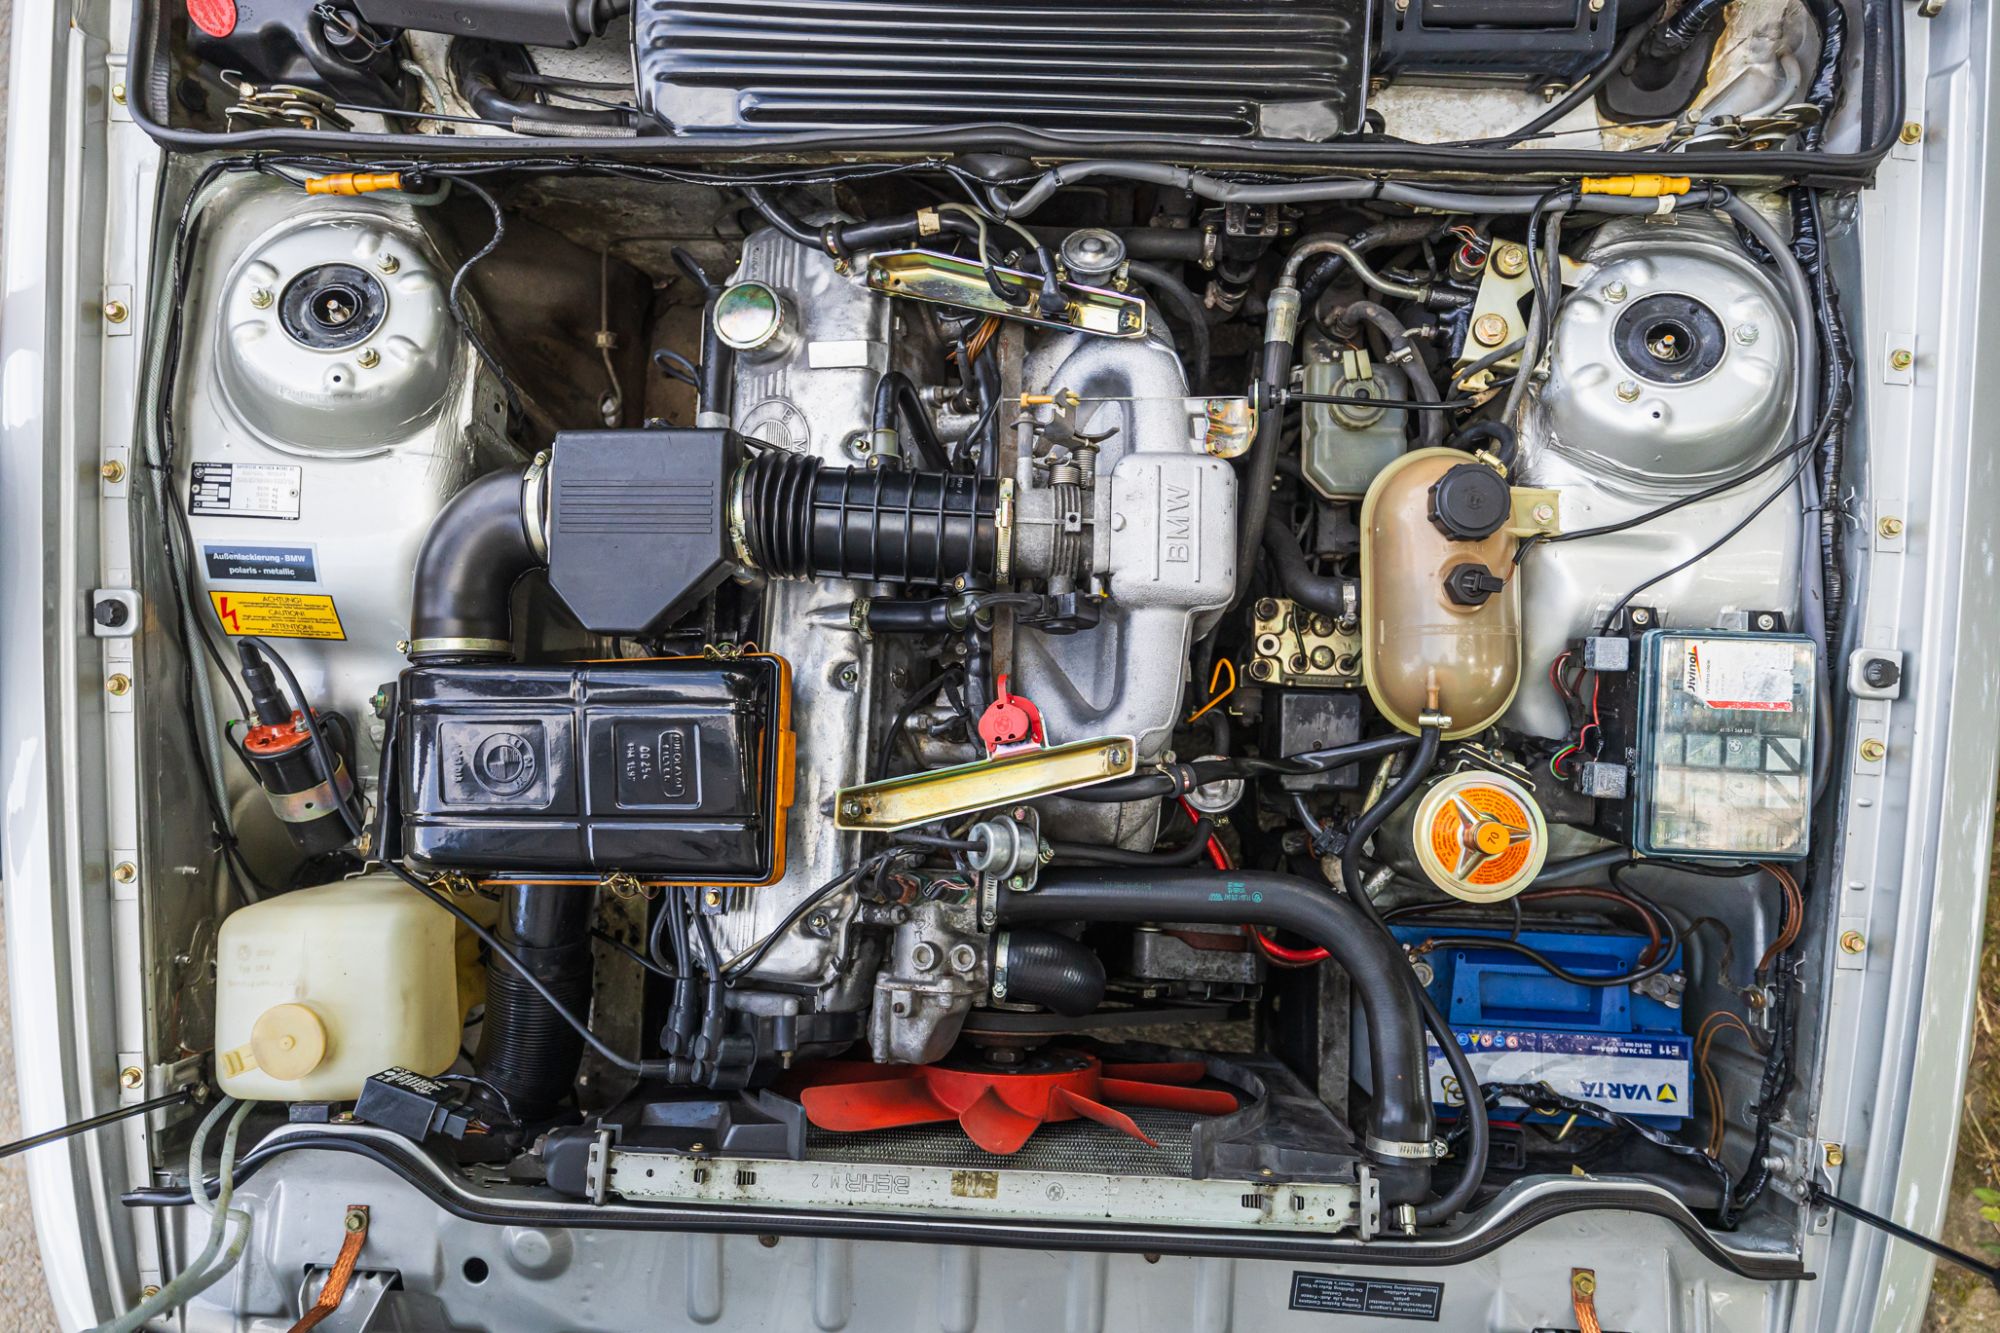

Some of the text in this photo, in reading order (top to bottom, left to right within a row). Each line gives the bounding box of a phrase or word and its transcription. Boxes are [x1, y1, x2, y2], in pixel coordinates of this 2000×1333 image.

[1165, 484, 1189, 563] BMW
[213, 553, 280, 563] Außenlackierung
[229, 567, 257, 575] polaris
[262, 596, 302, 604] ACHTUNG!
[268, 609, 305, 617] CAUTION!
[1687, 652, 1697, 692] Jivinol
[1487, 832, 1500, 845] 70
[1659, 1045, 1680, 1056] E11
[1579, 1081, 1652, 1102] VARTA
[811, 1173, 819, 1189] 2
[845, 1173, 911, 1196] BEHR
